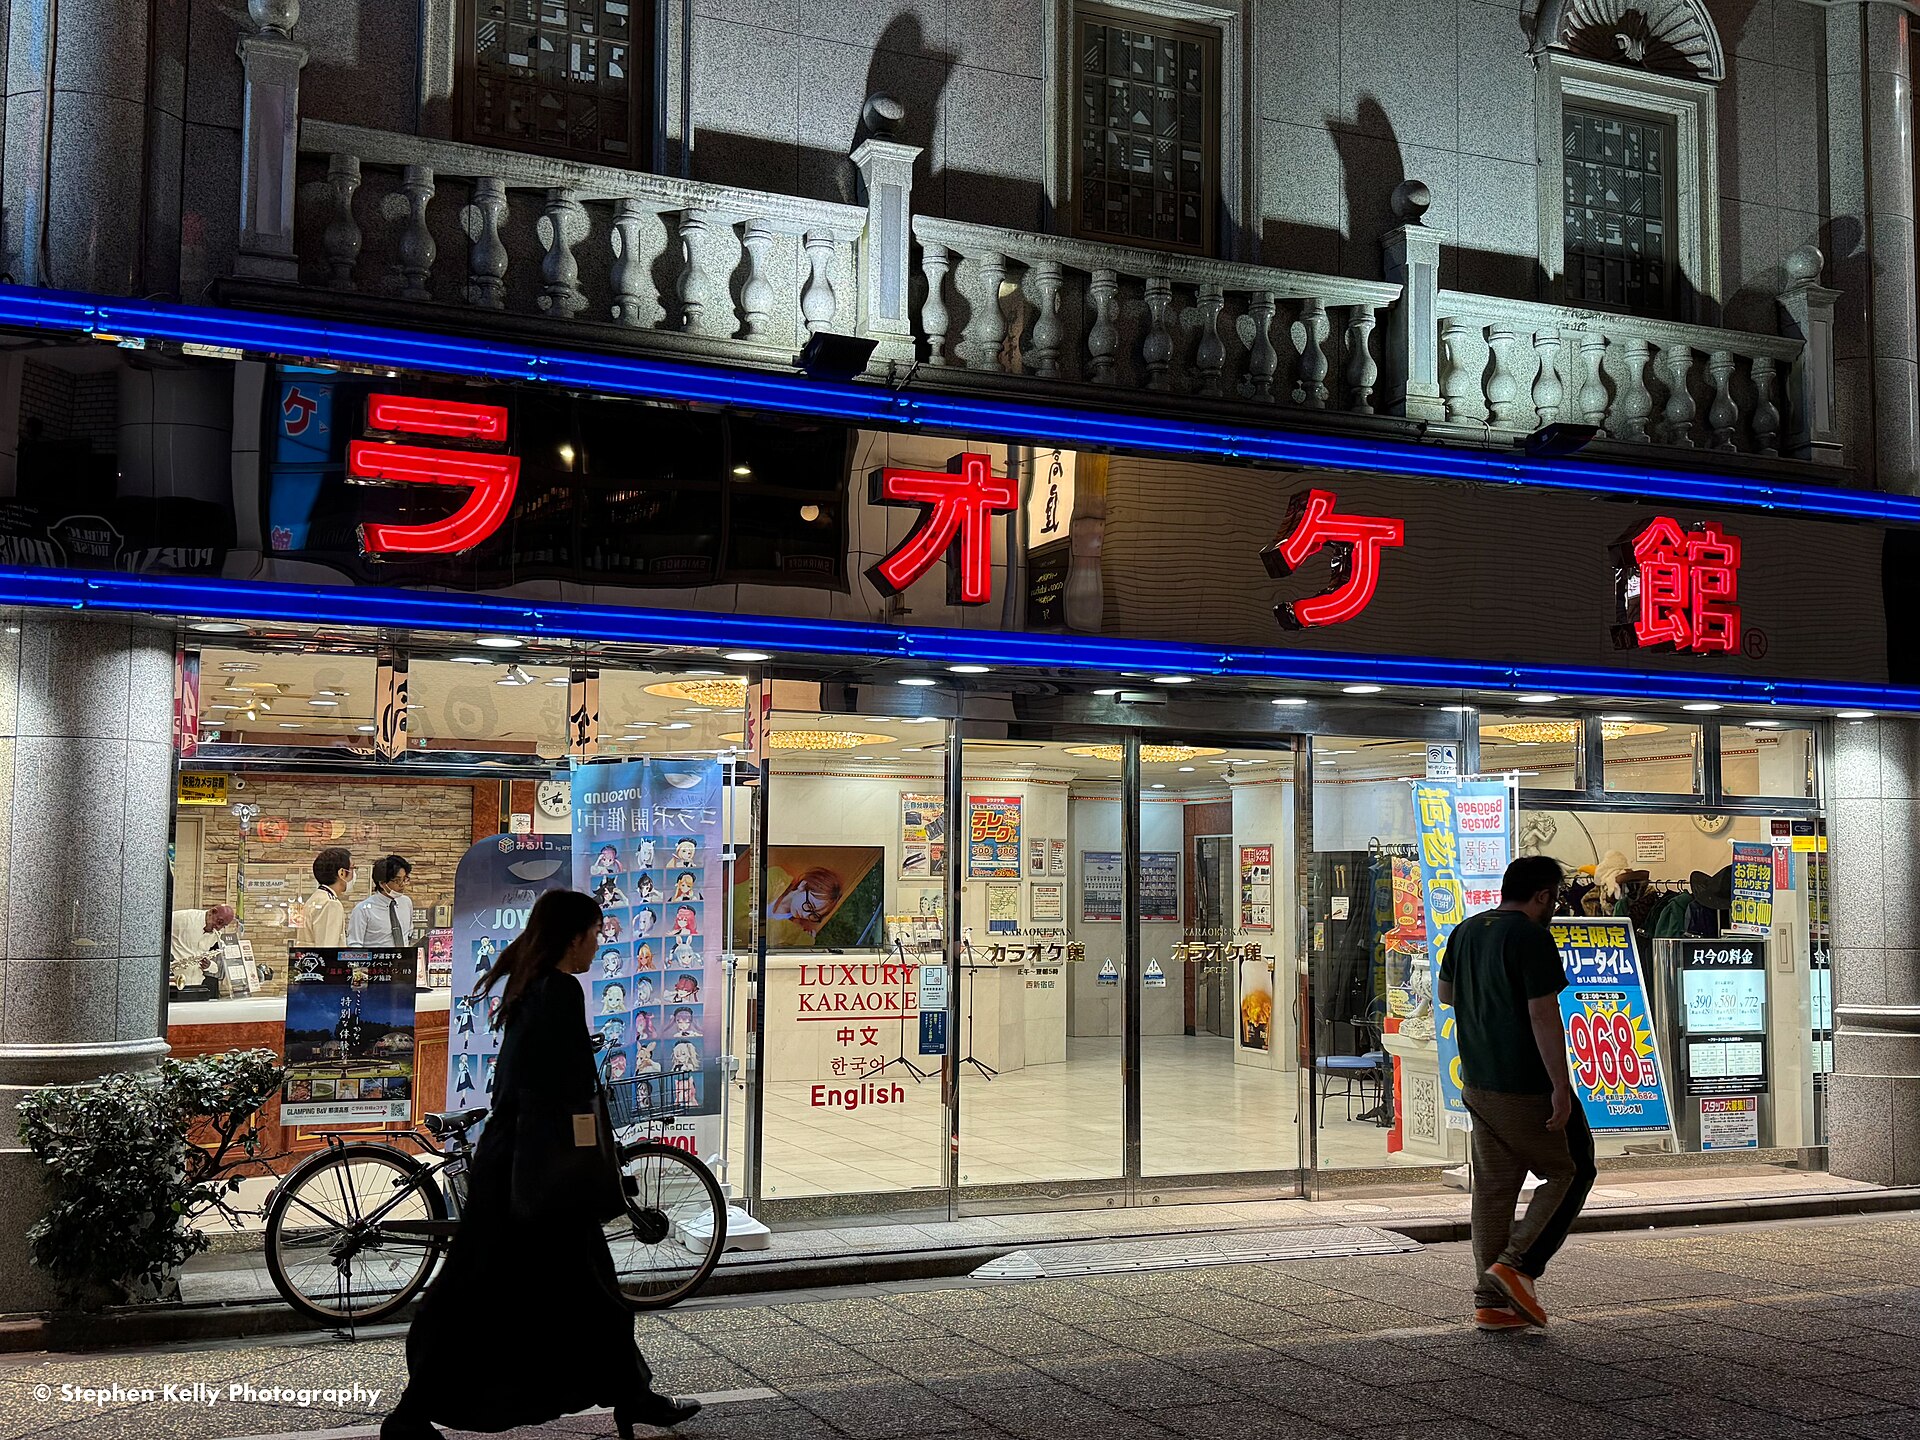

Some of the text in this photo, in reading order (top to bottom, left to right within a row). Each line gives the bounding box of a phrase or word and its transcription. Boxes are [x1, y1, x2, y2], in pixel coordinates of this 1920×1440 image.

[971, 810, 1003, 828] テレ
[971, 826, 1012, 843] ワーク
[1794, 825, 1812, 833] CSP
[516, 841, 553, 851] みるハコ
[1255, 849, 1269, 857] レンタル
[1733, 863, 1771, 880] お荷物
[1734, 878, 1771, 890] 預かります
[1001, 927, 1051, 937] KARAOKE
[1551, 926, 1629, 949] 学生限定
[987, 941, 1086, 963] カラオケ館
[1170, 941, 1262, 963] カラオケ館
[1692, 949, 1754, 965] 只今の料金
[799, 963, 919, 987] LUXURY
[1025, 980, 1056, 989] 西新宿店
[797, 992, 918, 1012] KARAOKE
[836, 1025, 879, 1047] 中文
[830, 1054, 885, 1076] 한국어
[810, 1082, 905, 1111] English
[286, 1108, 315, 1116] GLAMPING
